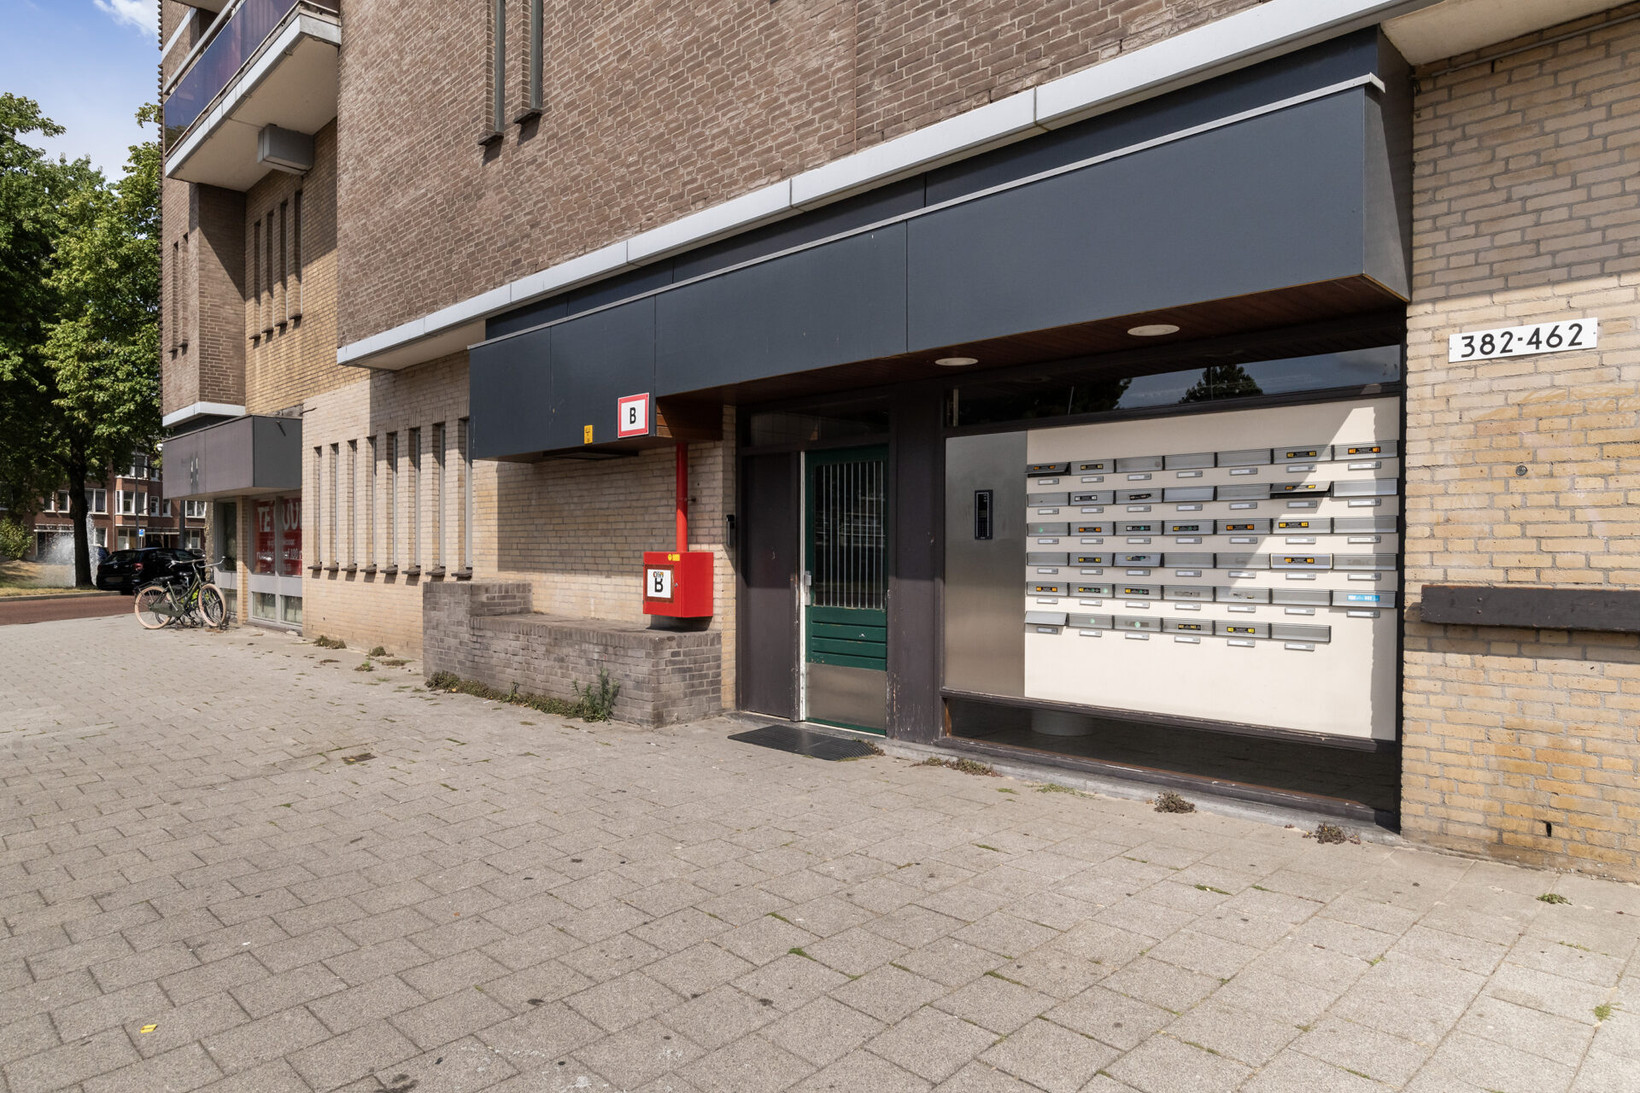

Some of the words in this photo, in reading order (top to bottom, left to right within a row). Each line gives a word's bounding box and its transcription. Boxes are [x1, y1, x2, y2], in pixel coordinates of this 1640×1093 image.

[1460, 322, 1583, 358] 382-462
[630, 406, 636, 424] B
[257, 506, 271, 533] TE
